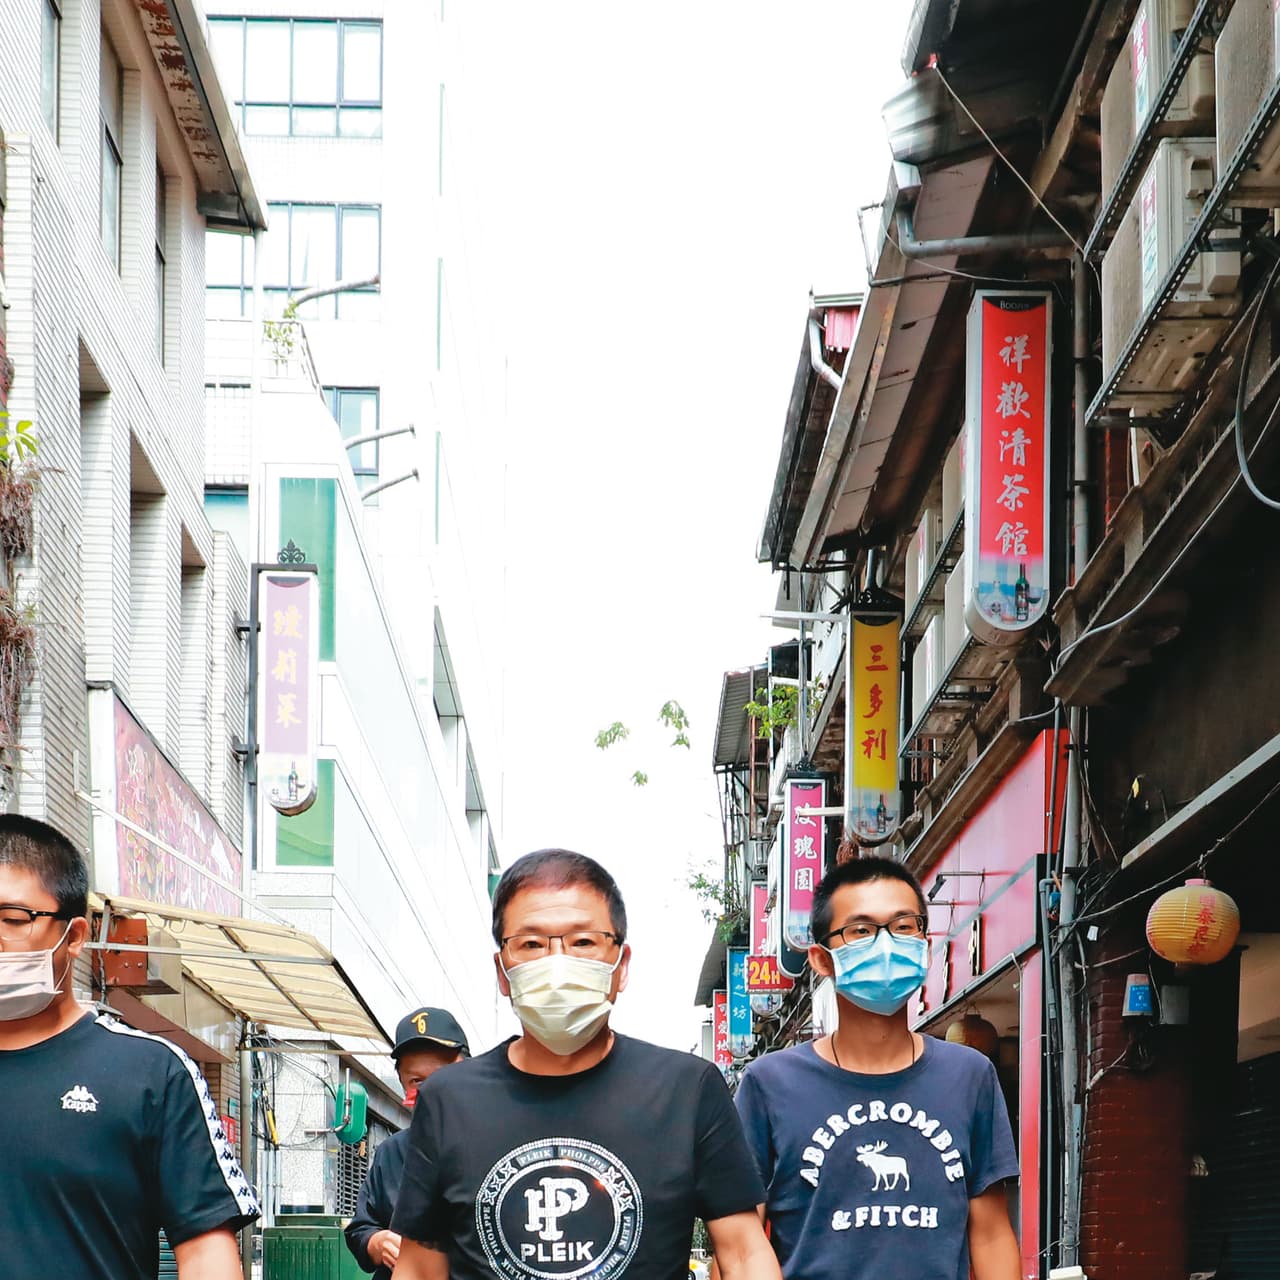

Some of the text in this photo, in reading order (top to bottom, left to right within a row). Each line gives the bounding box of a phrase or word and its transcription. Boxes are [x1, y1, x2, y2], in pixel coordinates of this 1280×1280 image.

[995, 334, 1033, 557] 祥歡清茶館
[861, 645, 889, 761] 三多利
[62, 1099, 97, 1113] Kappa
[799, 1100, 965, 1188] ABERCROMBIE
[520, 1241, 595, 1263] PLEIK
